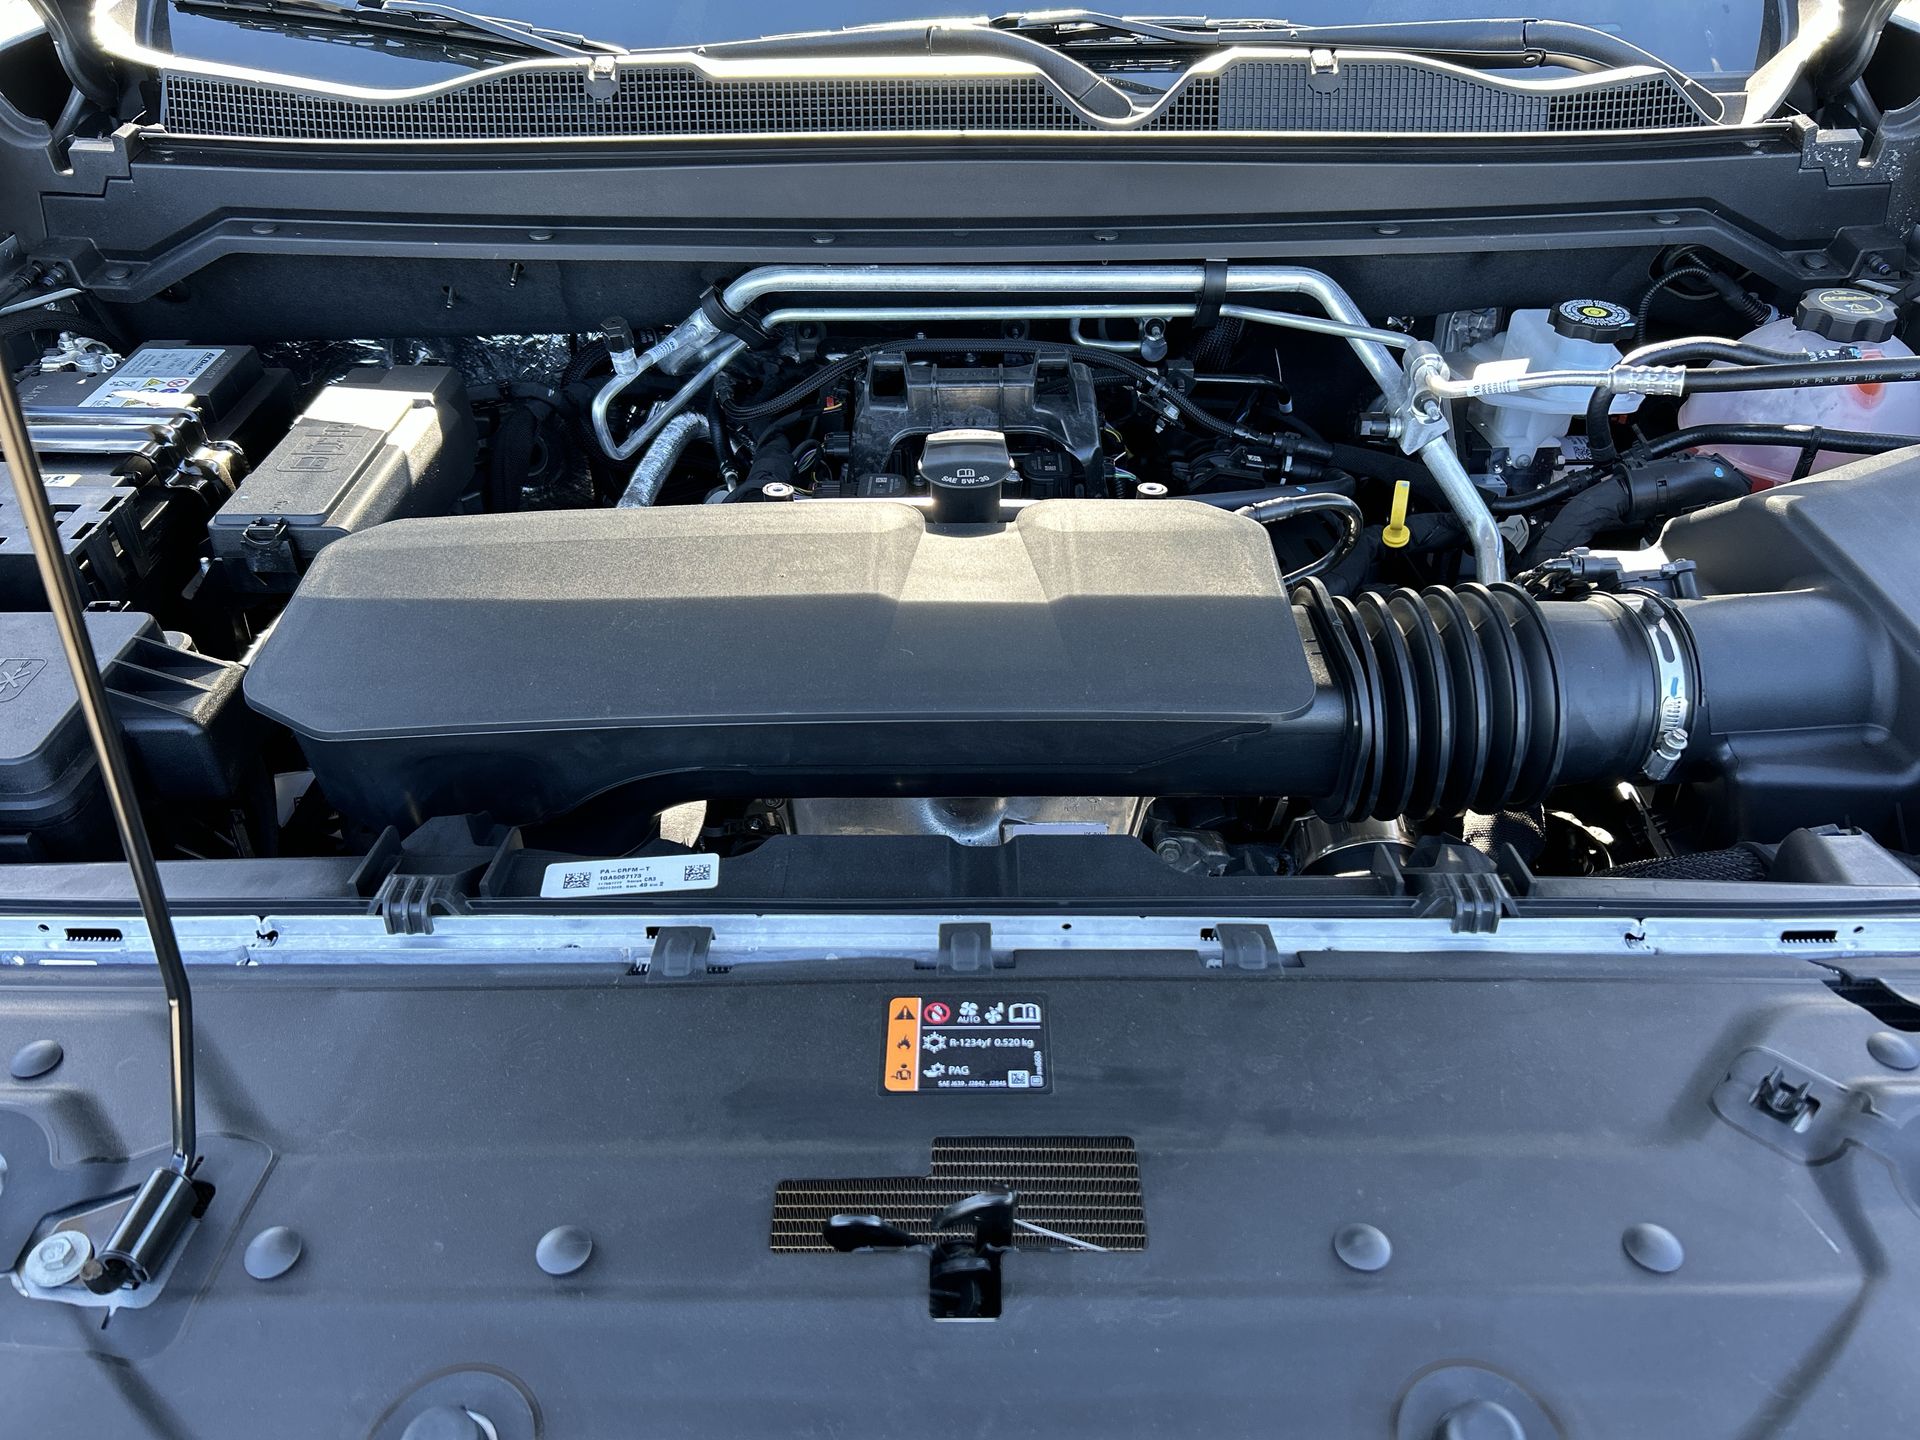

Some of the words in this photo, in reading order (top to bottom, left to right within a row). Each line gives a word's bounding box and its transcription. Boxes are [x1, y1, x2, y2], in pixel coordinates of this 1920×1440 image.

[188, 352, 215, 375] ACDelco
[941, 475, 958, 484] SAE
[961, 475, 990, 484] 5W-30
[957, 1015, 981, 1023] AUTO
[949, 1038, 992, 1049] R-1234yf
[994, 1038, 1020, 1047] 0.520
[1021, 1038, 1035, 1049] kg
[948, 1065, 970, 1075] PAG
